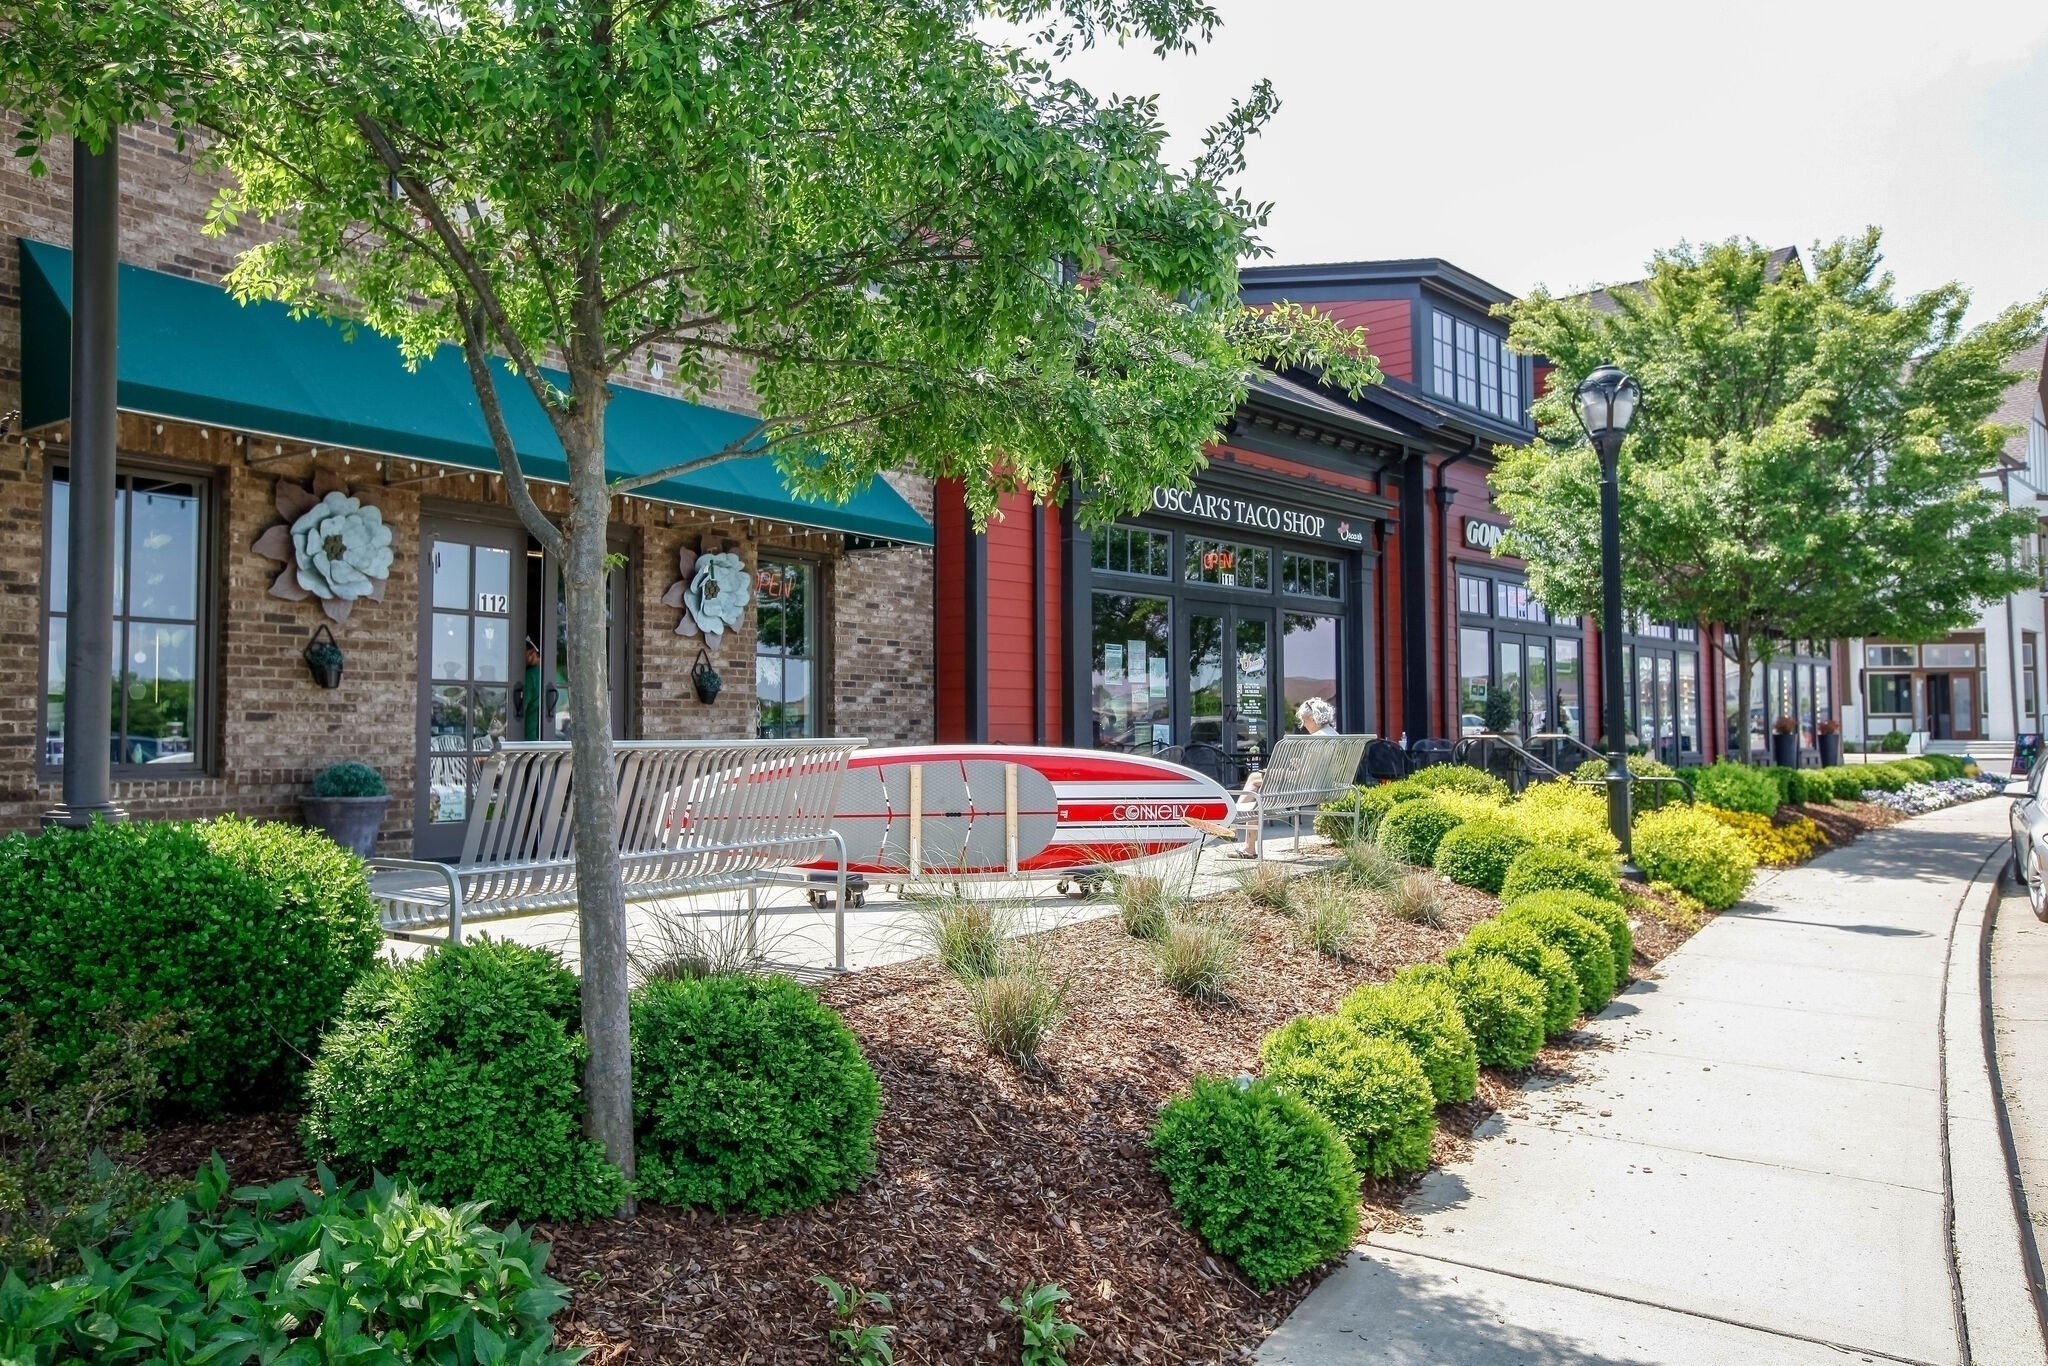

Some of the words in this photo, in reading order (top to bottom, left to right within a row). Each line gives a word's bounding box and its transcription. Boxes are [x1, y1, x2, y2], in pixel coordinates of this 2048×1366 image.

[1153, 485, 1231, 521] OSCAR'S
[1234, 500, 1281, 530] TACO
[1283, 510, 1325, 538] SHOP
[480, 593, 507, 613] 112
[1112, 804, 1190, 821] CONNELLY
